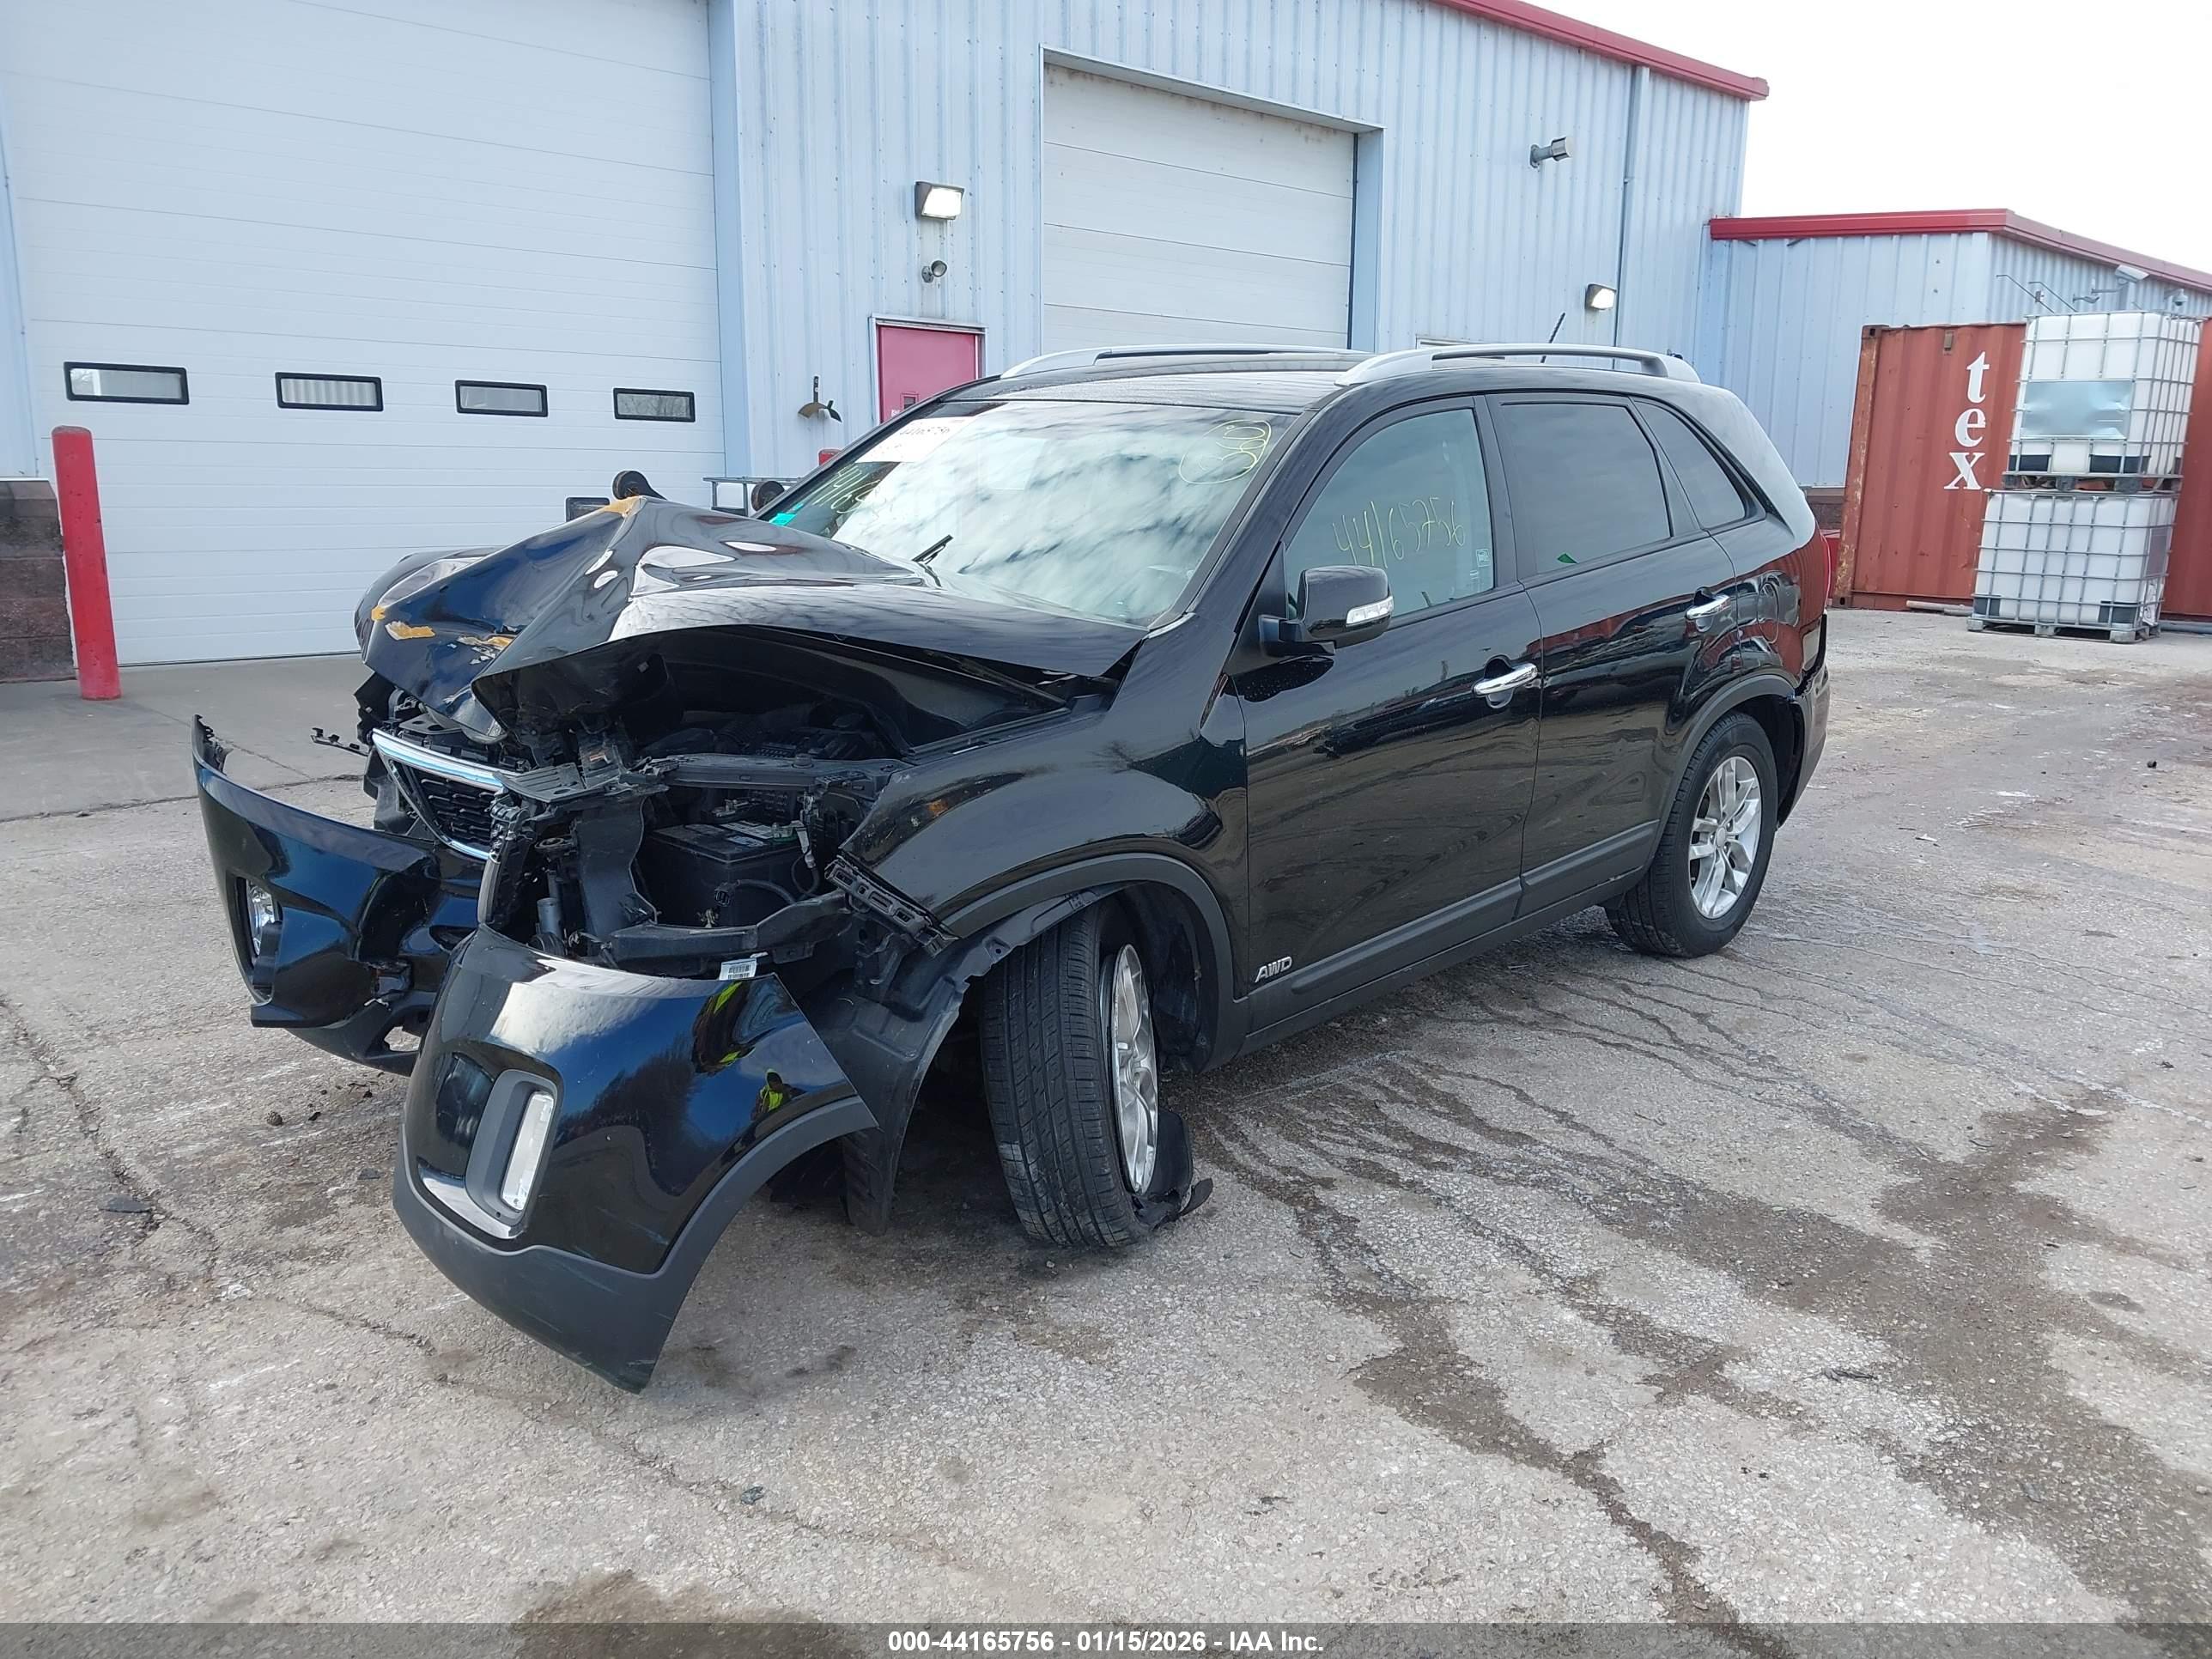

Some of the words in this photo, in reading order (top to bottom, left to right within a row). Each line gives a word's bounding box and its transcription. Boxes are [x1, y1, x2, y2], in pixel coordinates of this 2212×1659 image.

[1943, 350, 1990, 490] tex
[1332, 495, 1465, 568] 44165756
[1255, 957, 1292, 982] AWD
